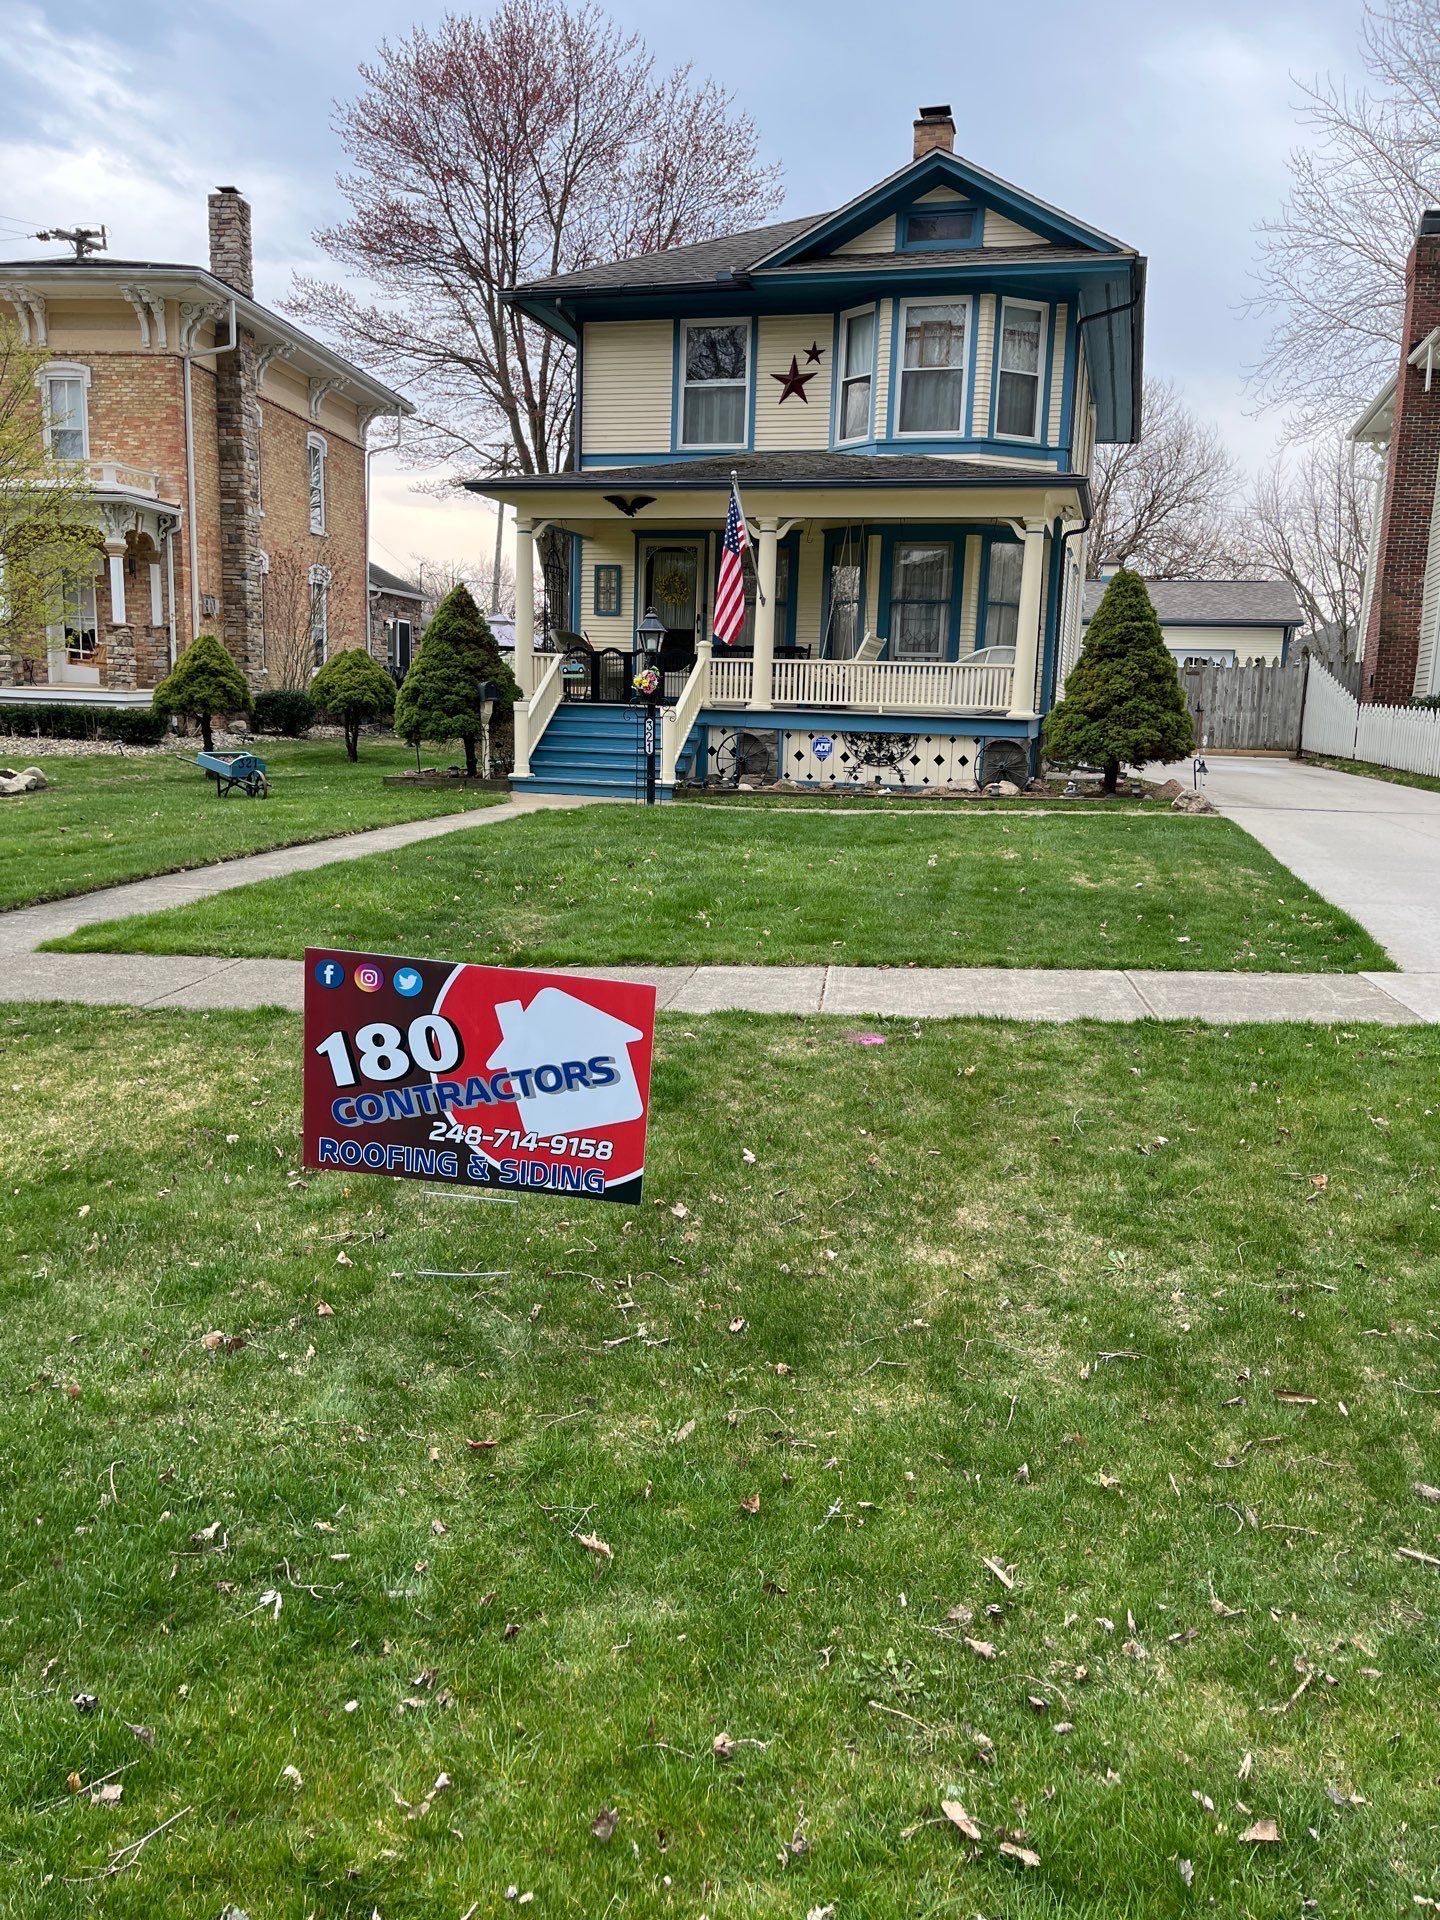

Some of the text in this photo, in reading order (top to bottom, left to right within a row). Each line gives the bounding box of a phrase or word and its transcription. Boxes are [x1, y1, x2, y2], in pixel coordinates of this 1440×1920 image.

[645, 720, 653, 753] 321
[815, 743, 830, 751] ADT
[239, 758, 257, 768] 321
[315, 1014, 464, 1087] 180
[331, 1056, 620, 1127] CONTRACTORS
[429, 1121, 614, 1161] 248-714-9158
[318, 1137, 605, 1194] ROOFING & SIDING
